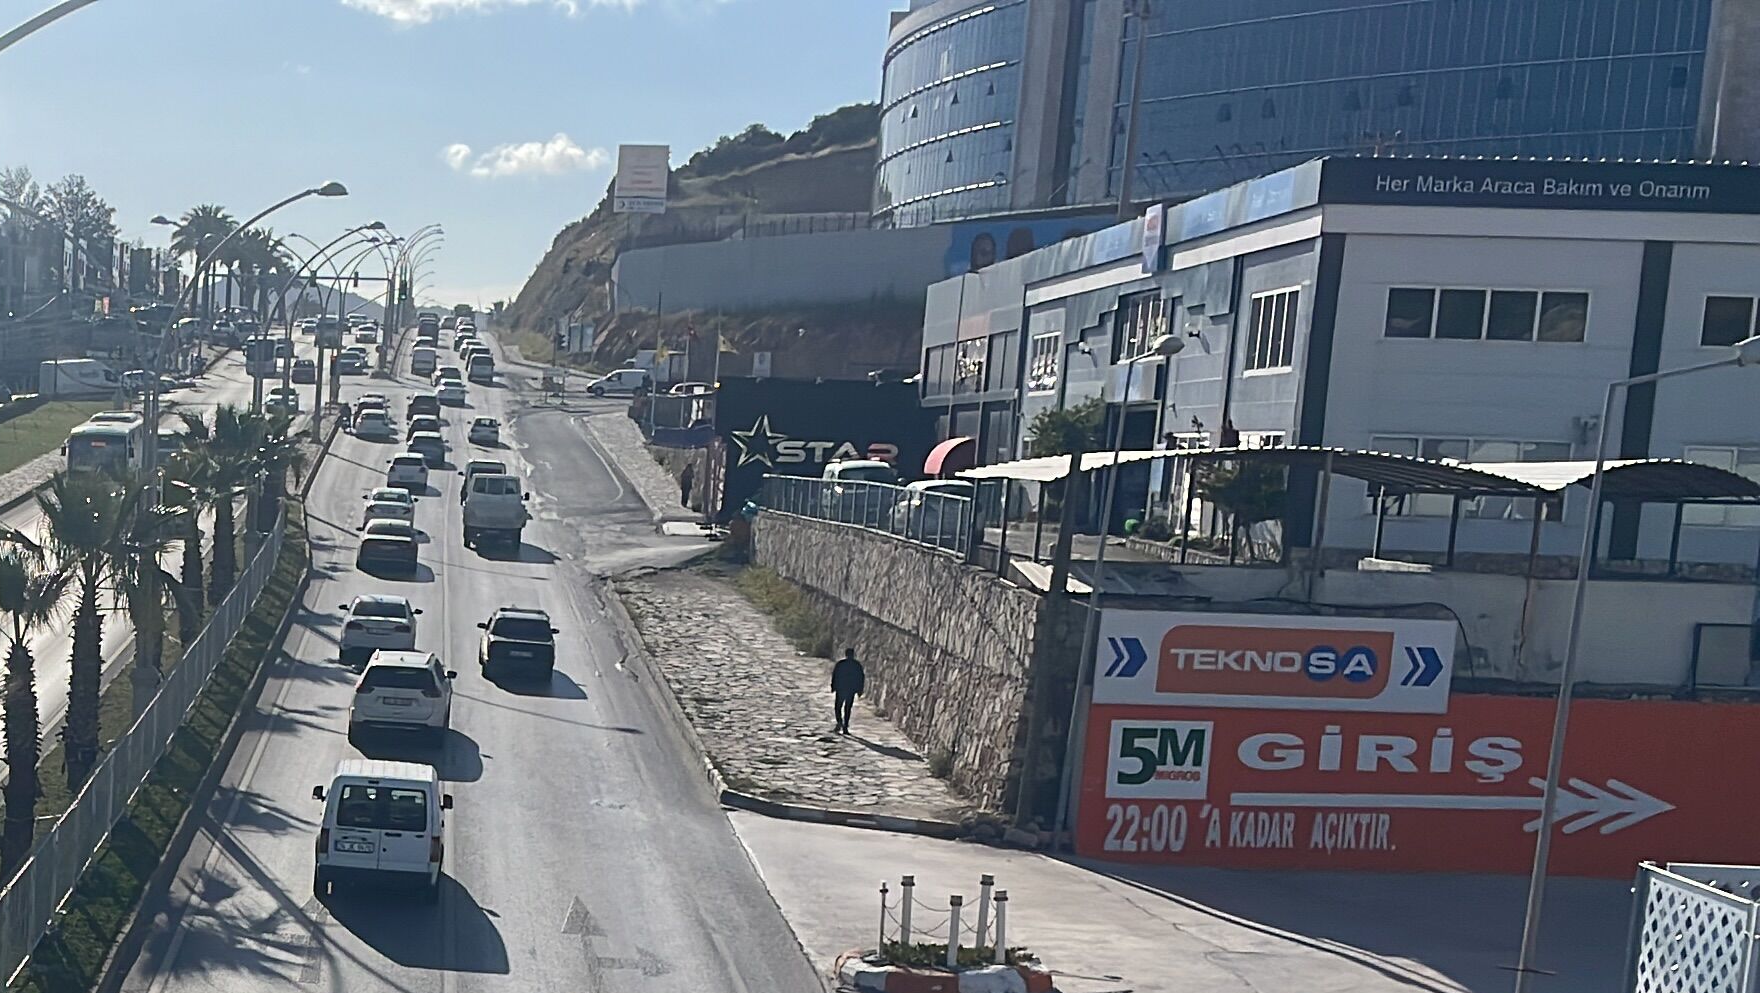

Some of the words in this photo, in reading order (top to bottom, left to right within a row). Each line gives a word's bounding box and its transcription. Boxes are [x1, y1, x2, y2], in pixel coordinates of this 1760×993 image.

[1375, 175, 1411, 193] Her
[1416, 175, 1474, 194] Marka
[1480, 177, 1536, 195] Araca
[1543, 178, 1603, 197] Bakım
[1609, 183, 1632, 197] ve
[1639, 180, 1711, 200] Onarım
[775, 441, 899, 465] STAR
[1169, 648, 1375, 678] TEKNOSA
[1117, 727, 1206, 785] 5M
[1237, 725, 1523, 783] GİRİŞ
[1103, 804, 1188, 852] 22:00
[1228, 811, 1296, 850] KADAR
[1310, 812, 1397, 855] AÇIKTIR.
